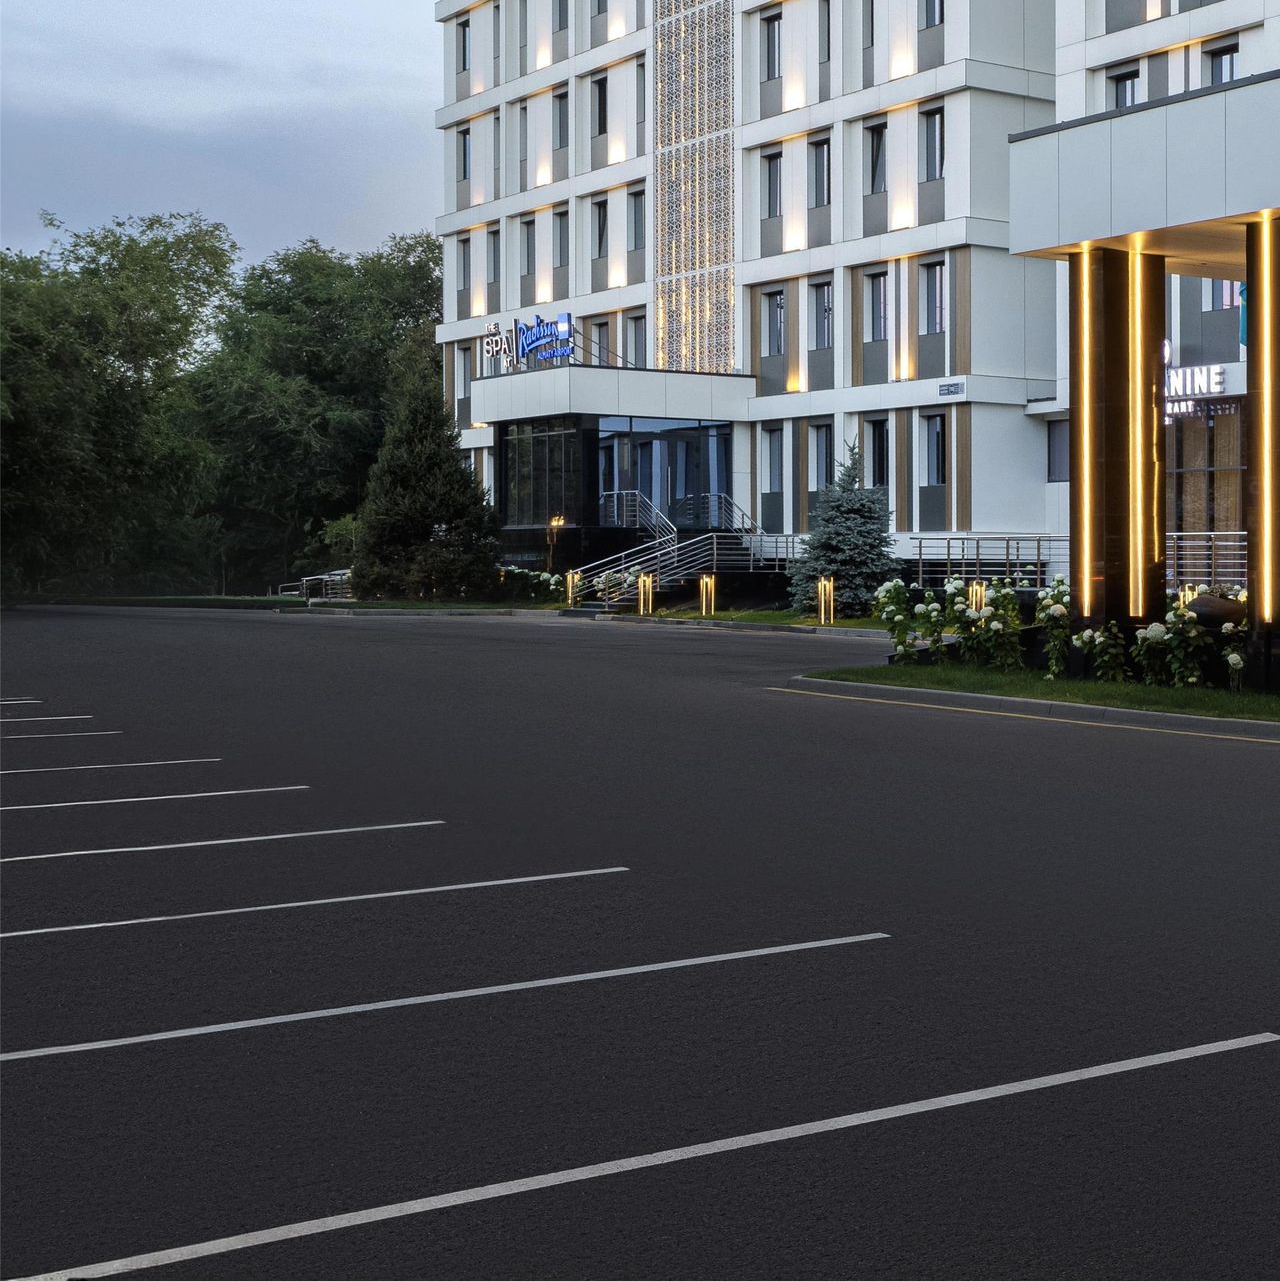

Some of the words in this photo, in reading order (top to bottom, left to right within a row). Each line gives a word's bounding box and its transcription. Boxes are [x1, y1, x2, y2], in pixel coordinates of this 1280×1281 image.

[485, 336, 510, 357] SPA
[518, 315, 558, 358] Radisson
[1165, 365, 1223, 396] NINE
[1166, 401, 1194, 413] RANT
